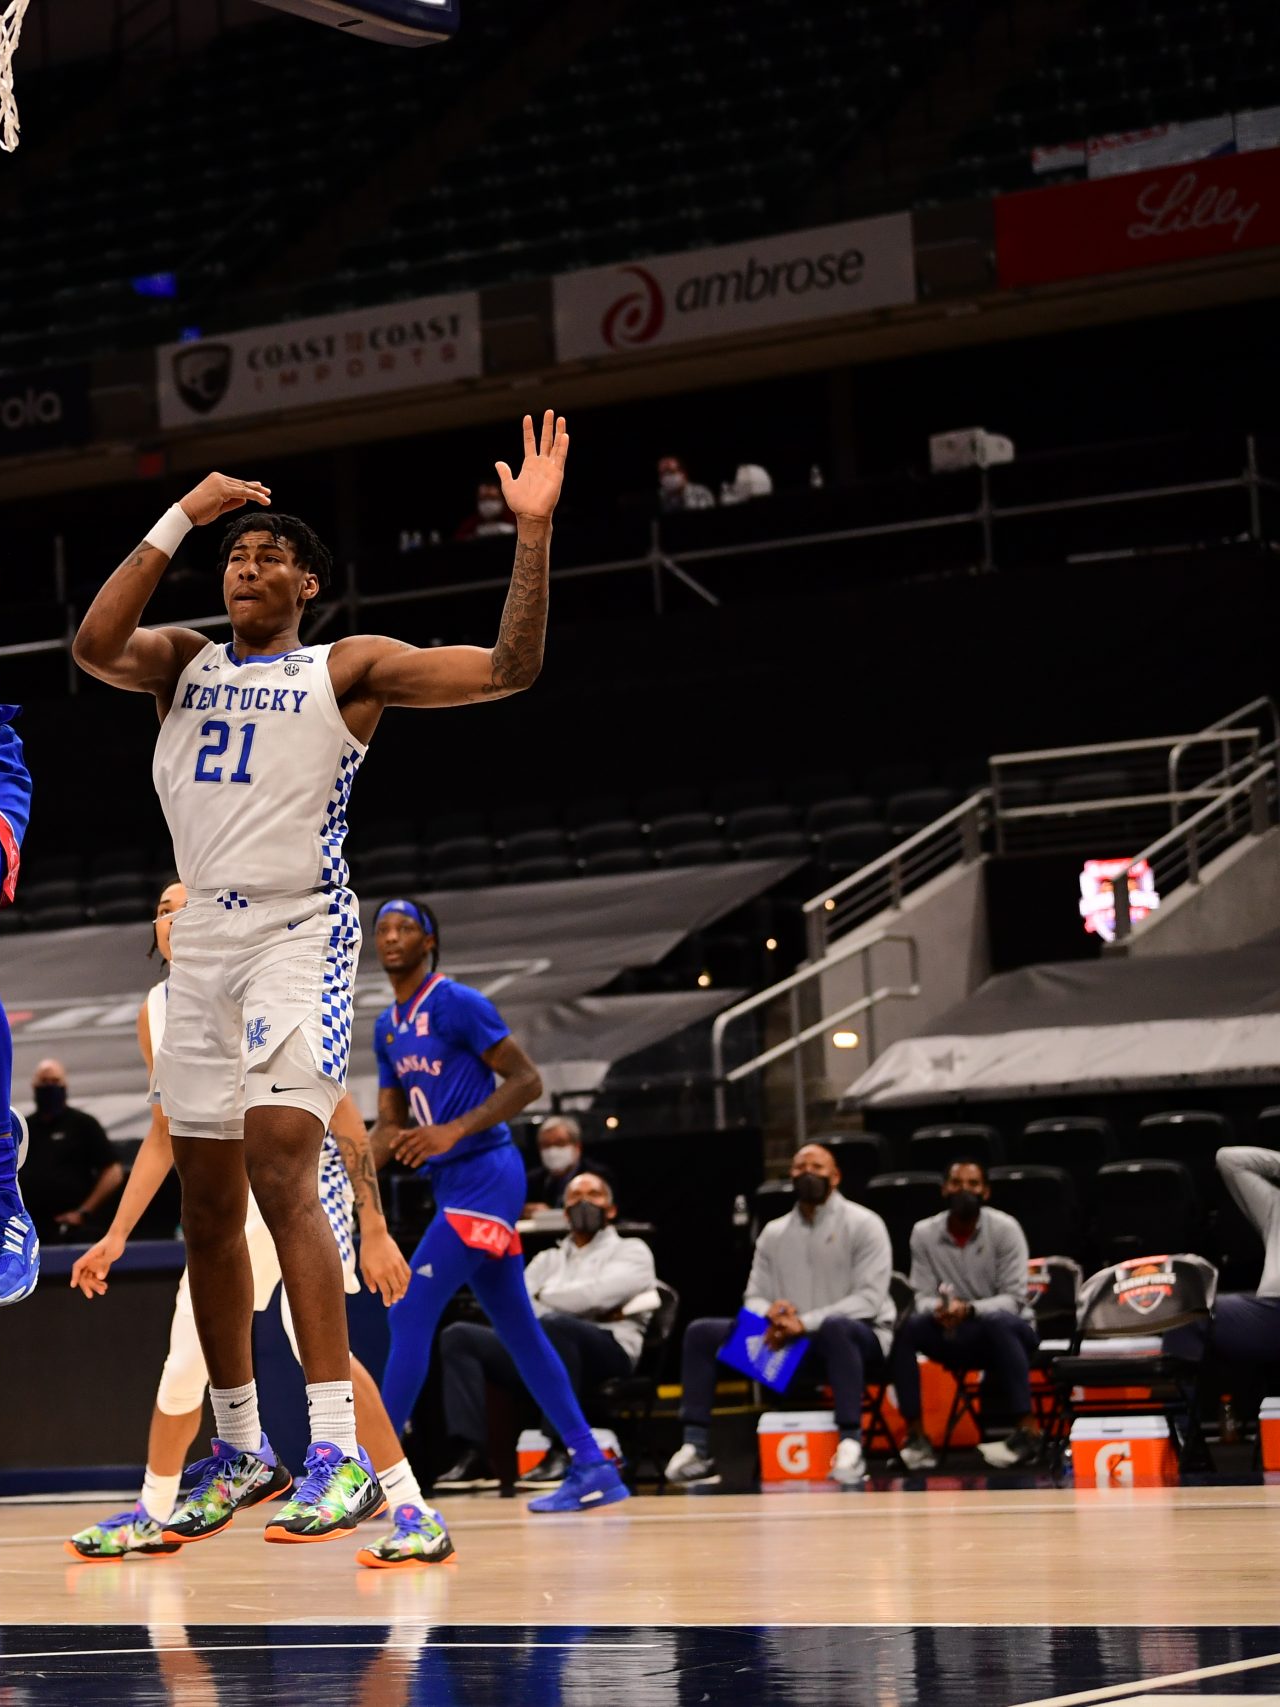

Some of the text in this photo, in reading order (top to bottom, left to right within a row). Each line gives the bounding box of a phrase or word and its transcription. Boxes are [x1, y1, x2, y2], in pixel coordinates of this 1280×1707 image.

[1126, 171, 1261, 243] Lilly
[676, 247, 865, 313] ambrose
[247, 334, 336, 372] COAST
[369, 314, 462, 352] COAST
[181, 683, 308, 714] KENTUCKY
[194, 719, 256, 784] 21
[776, 1433, 811, 1475] G
[1093, 1441, 1135, 1489] G
